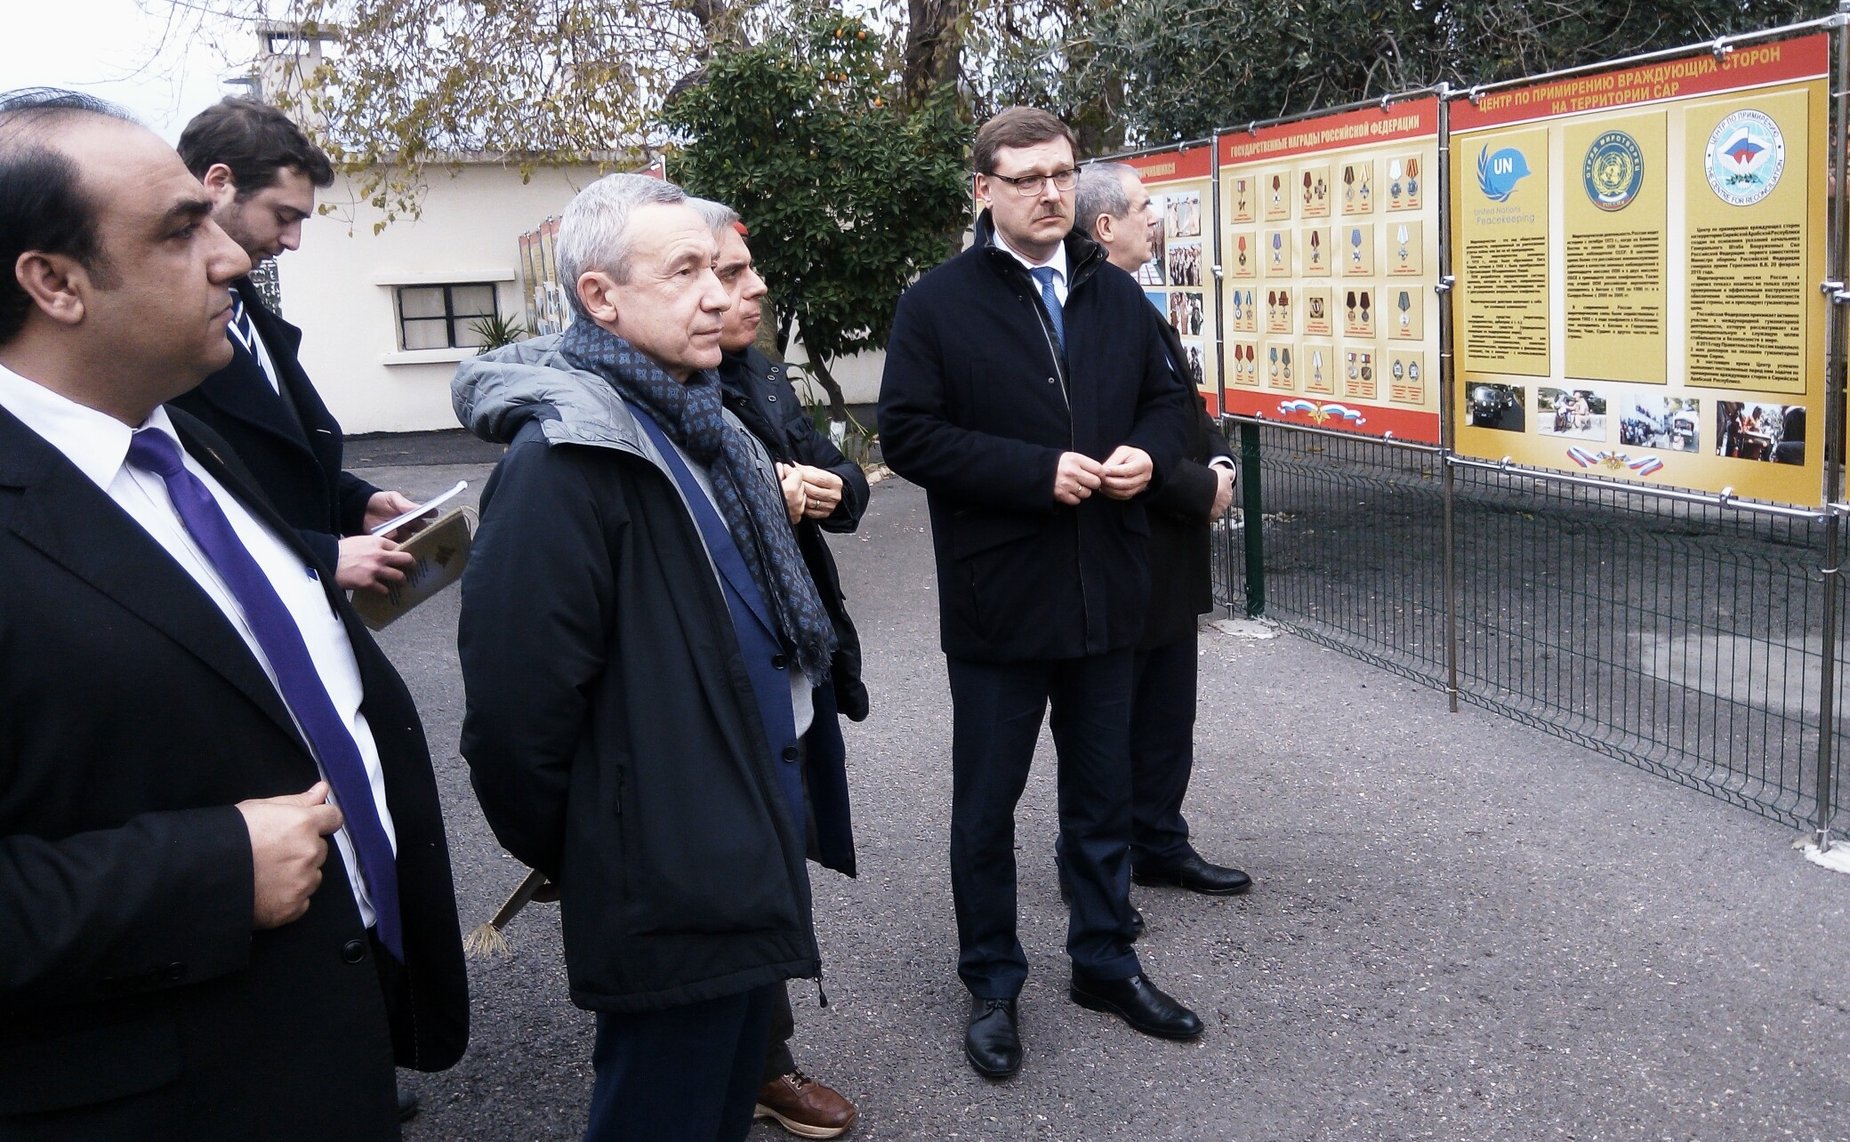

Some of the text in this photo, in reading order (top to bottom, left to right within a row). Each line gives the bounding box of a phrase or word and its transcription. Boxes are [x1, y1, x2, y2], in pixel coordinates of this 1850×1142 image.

[1479, 46, 1781, 113] ЦЕНТР ПО ПРИМИРЕНИЮ ВРАЖДУЮЩИХ СТОРОН
[1552, 82, 1680, 114] НА ТЕРРИТОРИИ САР
[1727, 115, 1737, 123] ПО
[1230, 115, 1420, 158] ГОСУДАРСТВЕННЫЕ НАГРАДЫ РОССИЙСКОЙ ФЕДЕРАЦИИ
[1494, 157, 1513, 175] UN
